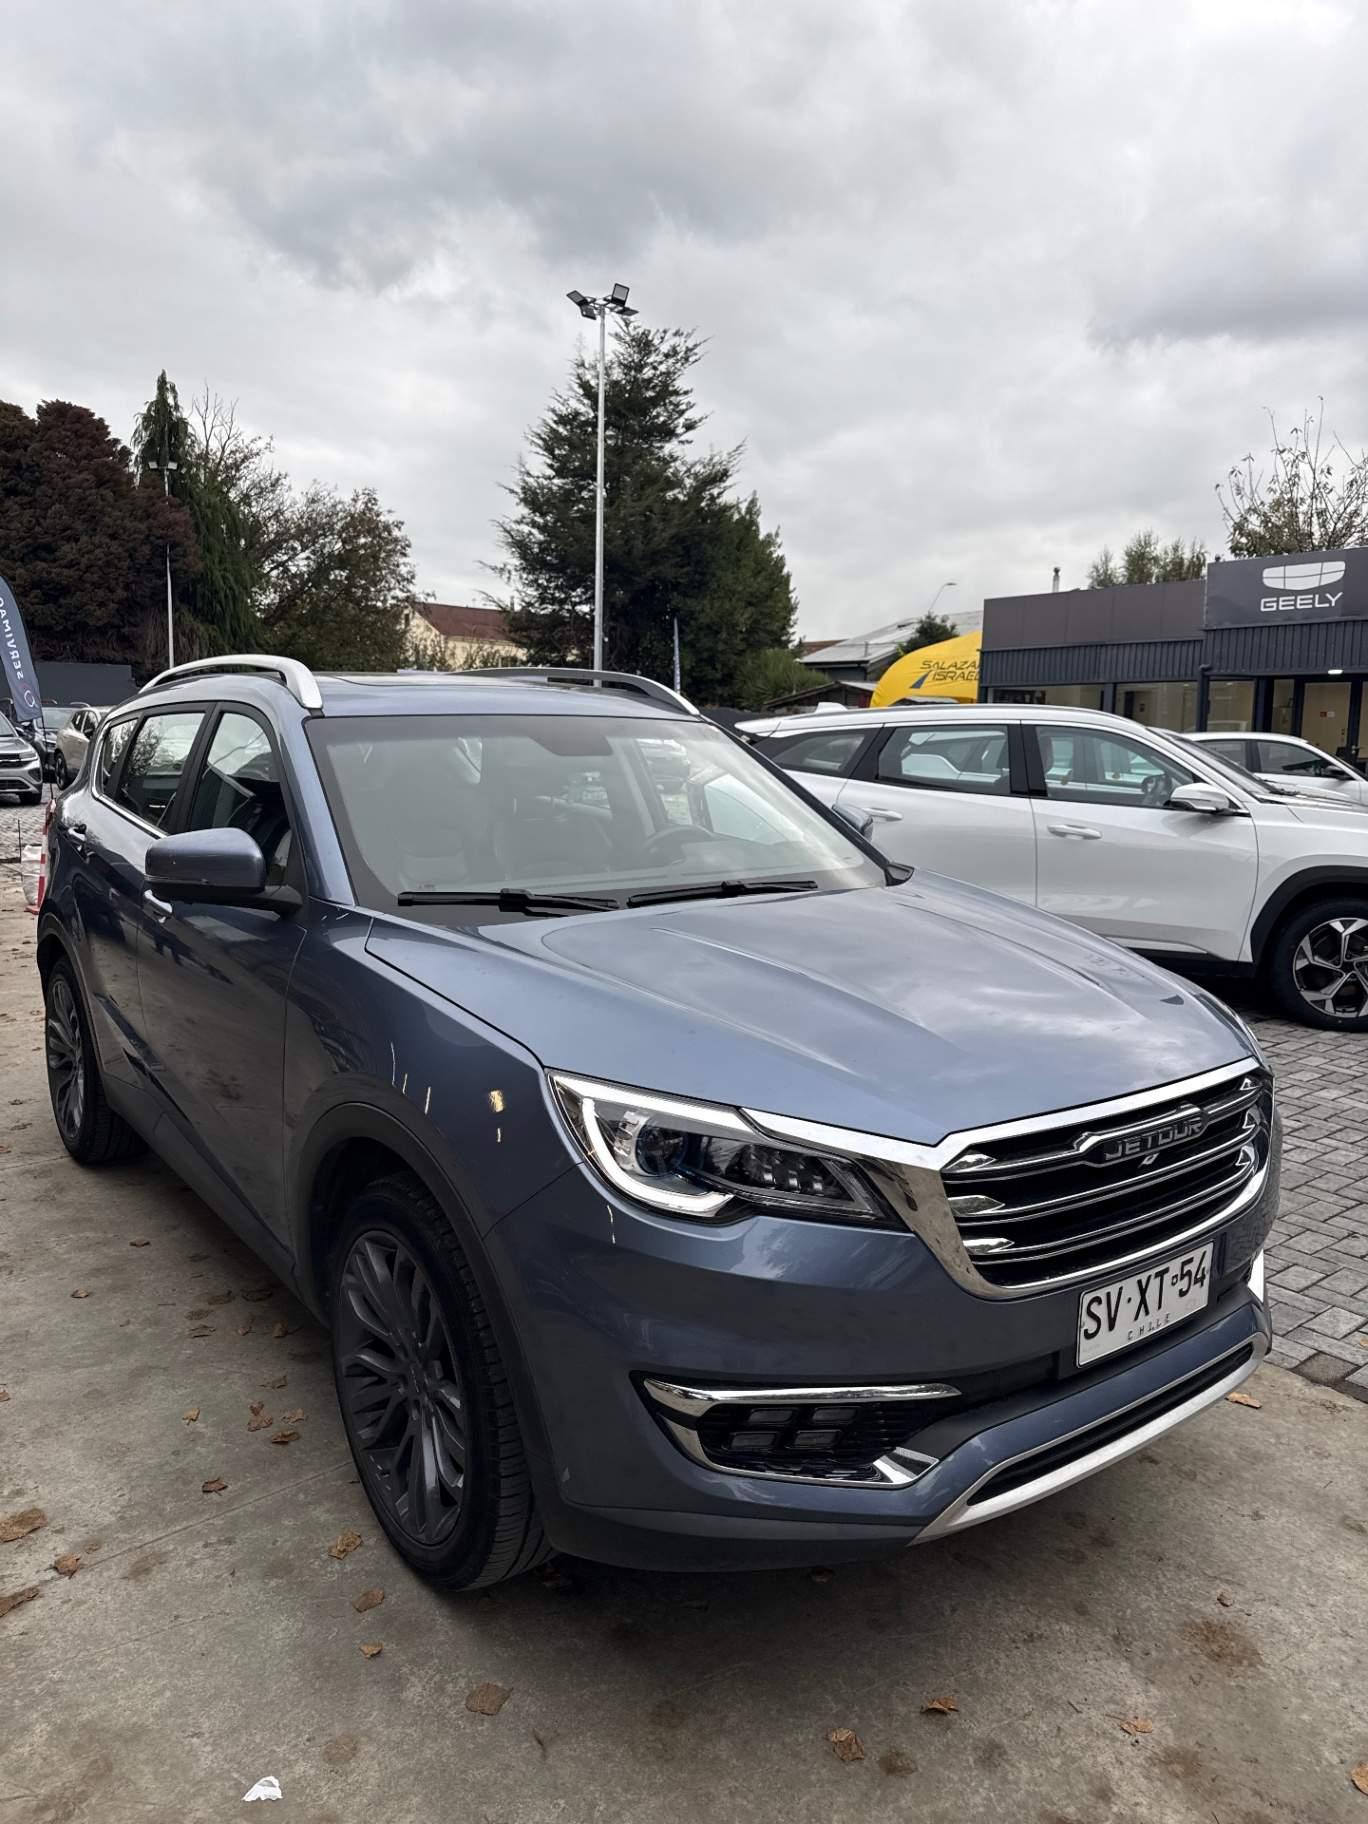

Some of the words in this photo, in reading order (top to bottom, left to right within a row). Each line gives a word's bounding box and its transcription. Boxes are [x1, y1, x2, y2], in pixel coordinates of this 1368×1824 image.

[1260, 591, 1343, 612] GEELY
[919, 659, 979, 671] SALAZA
[1104, 1116, 1202, 1161] JETOUR
